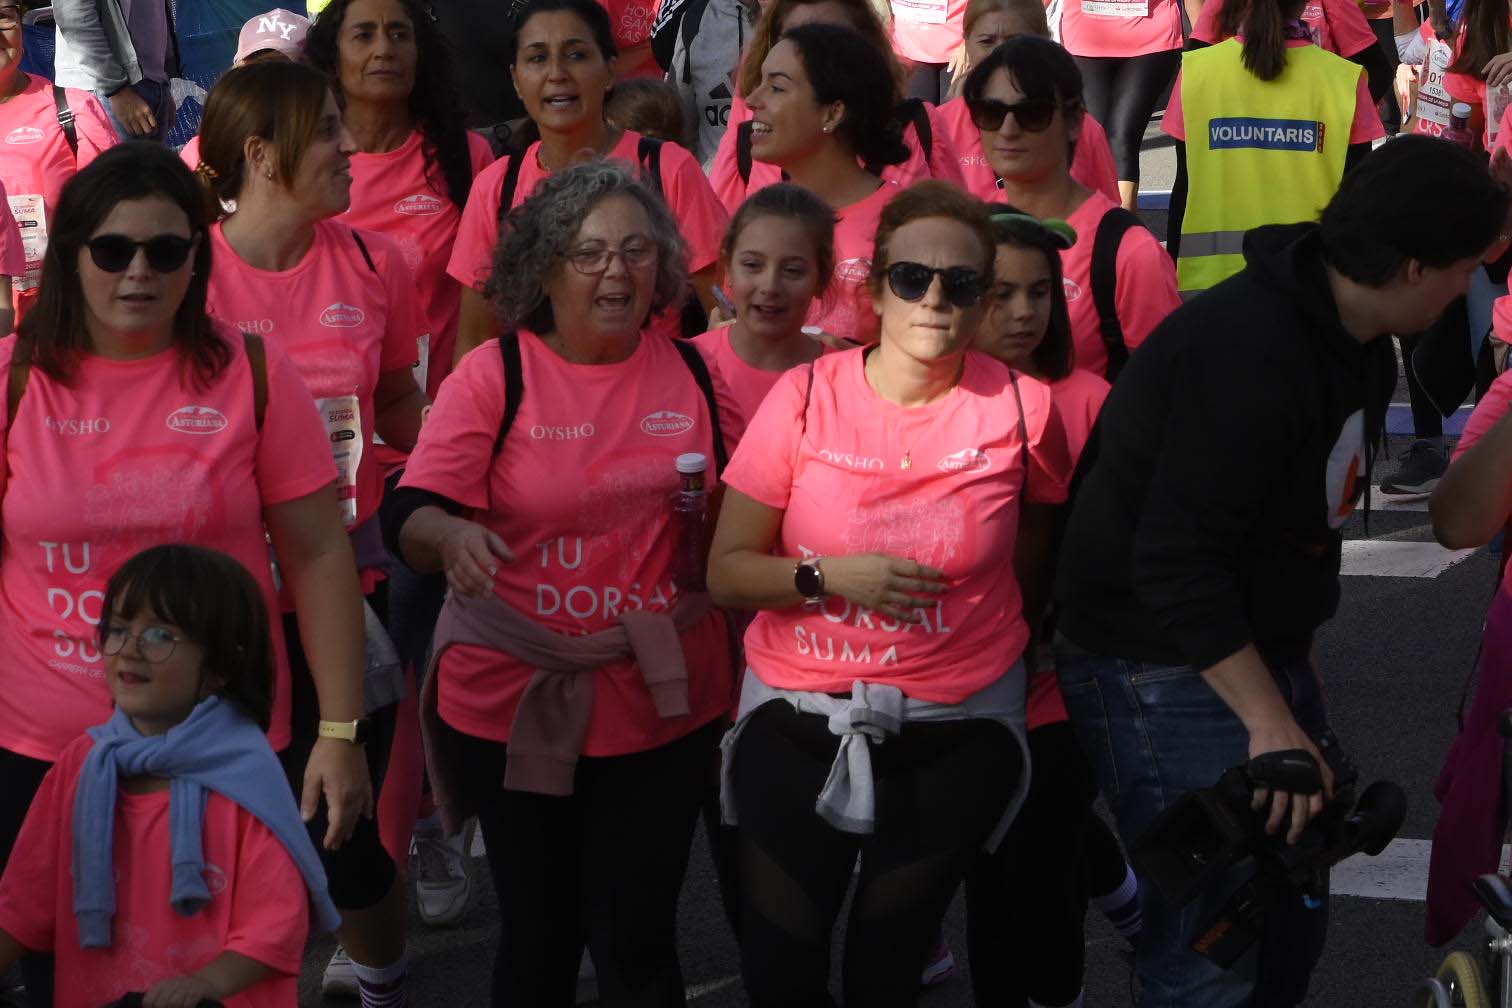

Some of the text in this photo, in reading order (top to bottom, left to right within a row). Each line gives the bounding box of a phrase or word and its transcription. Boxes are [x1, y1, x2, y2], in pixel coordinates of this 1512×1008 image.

[256, 14, 297, 41] NY
[1211, 126, 1314, 144] VOLUNTARIS
[328, 413, 355, 423] SUMA
[529, 422, 596, 441] OYSHO
[39, 540, 91, 575] TU
[536, 536, 583, 571] TU
[47, 588, 106, 626] DO
[536, 581, 678, 620] DORSA
[53, 629, 101, 664] SU
[793, 625, 901, 667] SUMA
